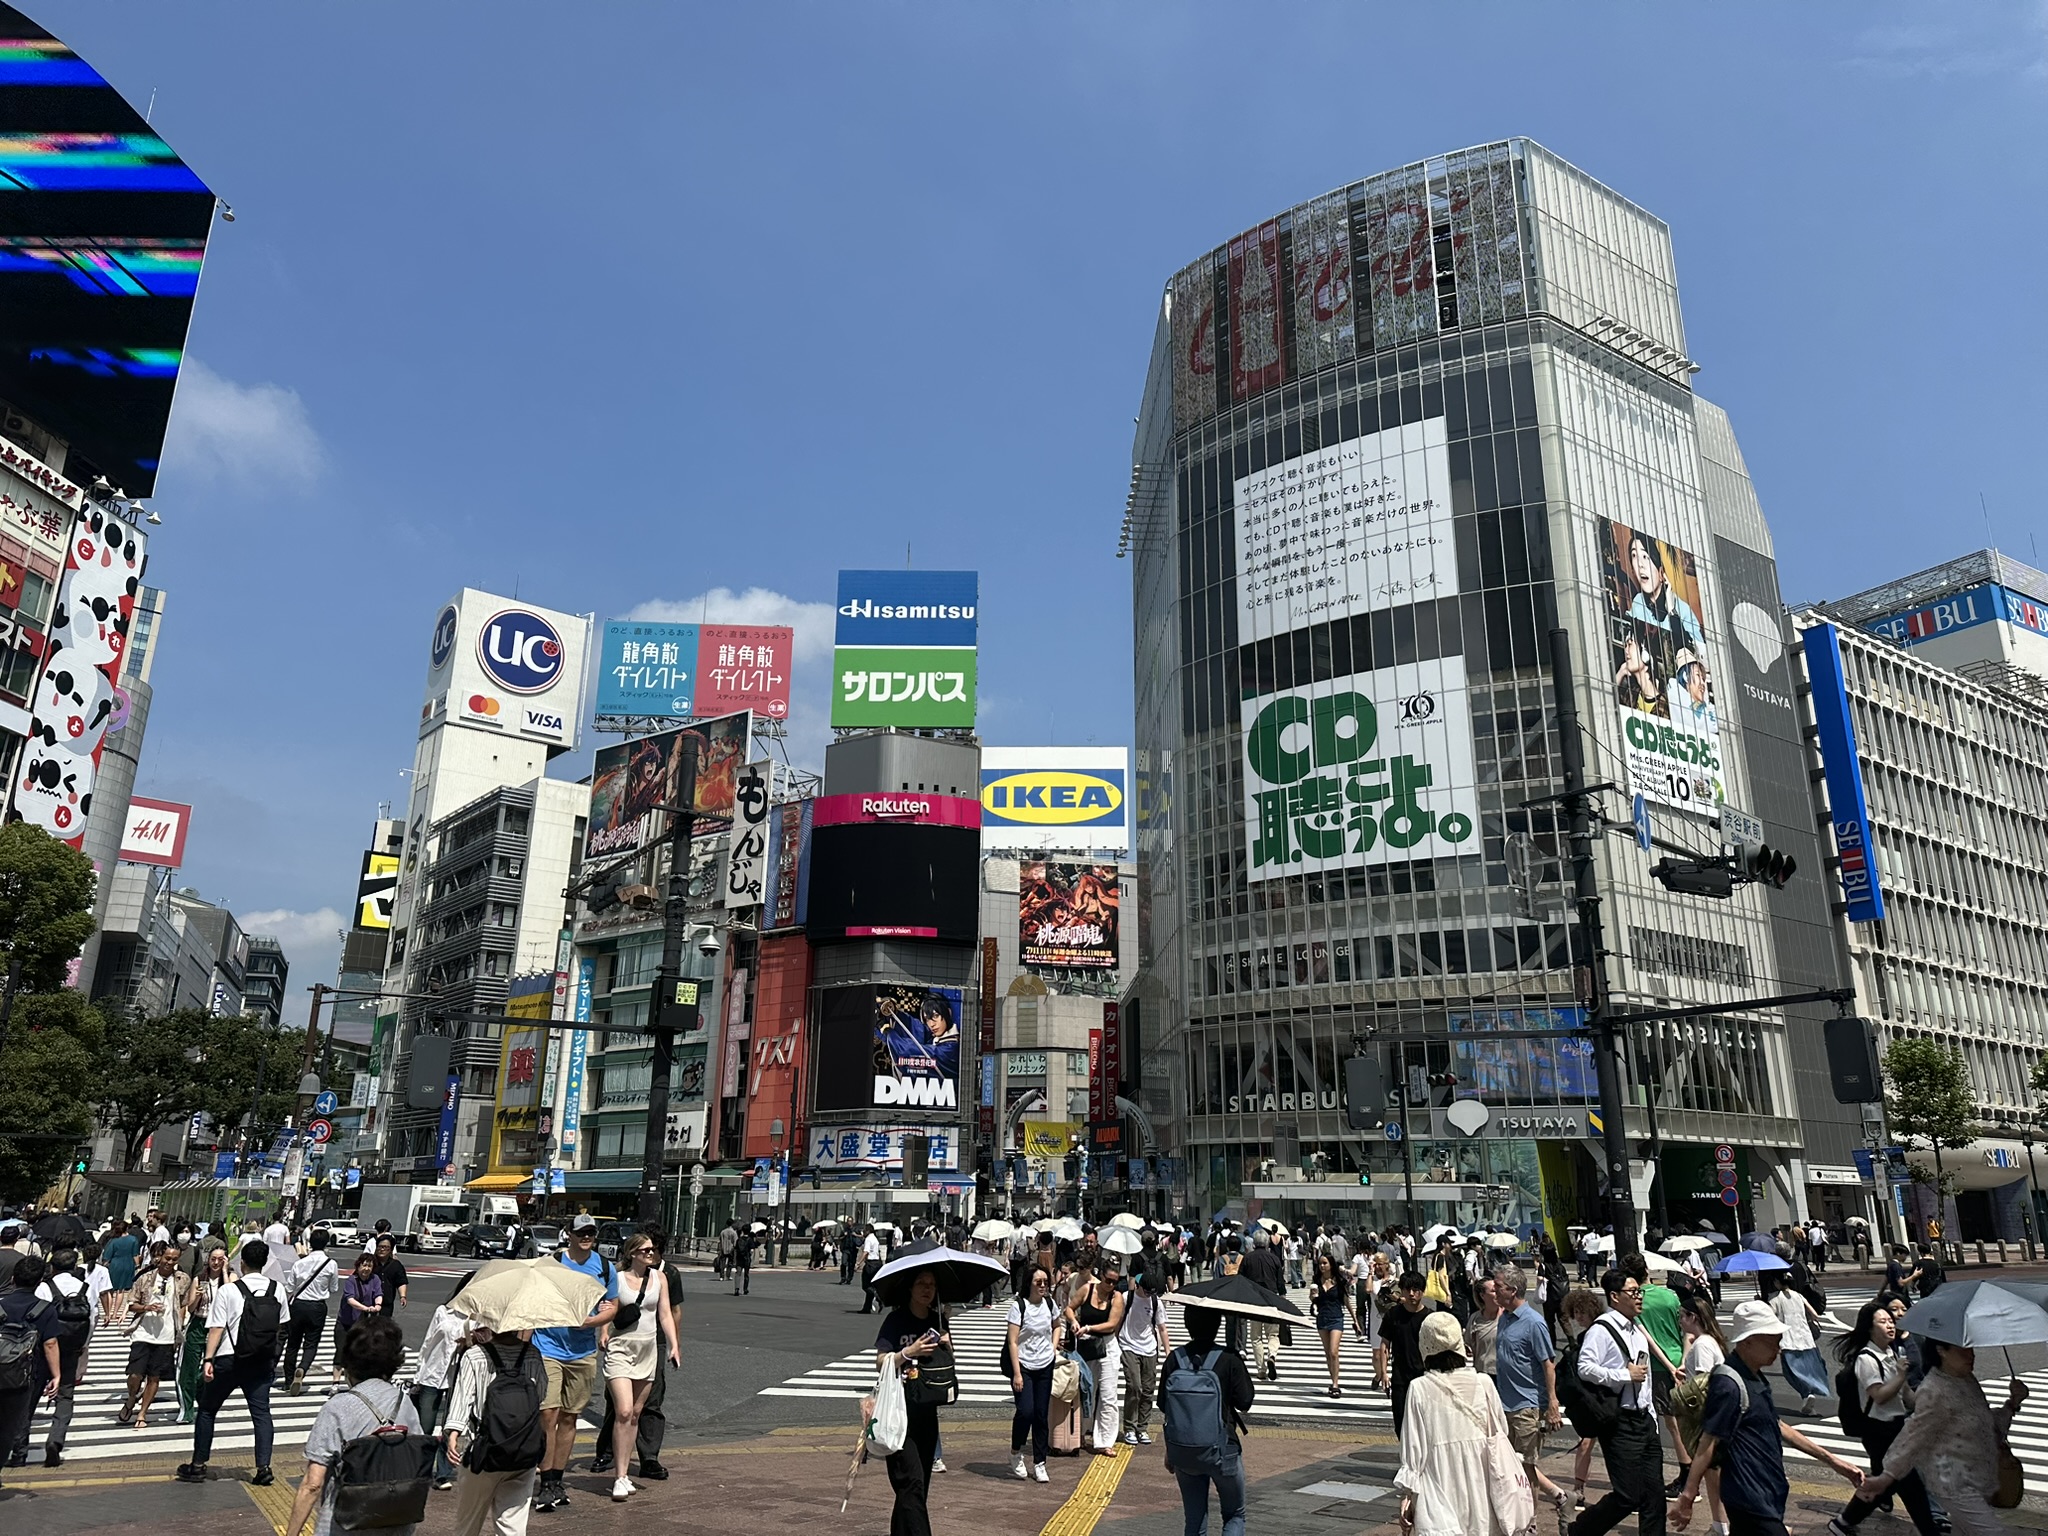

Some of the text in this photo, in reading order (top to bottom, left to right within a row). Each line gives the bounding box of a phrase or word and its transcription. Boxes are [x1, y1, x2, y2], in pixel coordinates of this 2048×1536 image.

[81, 543, 90, 555] こ
[839, 599, 975, 619] Hisamitsu
[112, 635, 121, 648] れ
[434, 618, 455, 655] UC
[610, 626, 694, 637] のど、直接、うるおう
[706, 629, 788, 641] のど、直接、うるおう
[488, 624, 556, 673] UC
[622, 641, 679, 665] 龍角散
[718, 644, 774, 668] 龍角散
[612, 666, 688, 689] ダイレクト
[709, 669, 783, 692] ダイレクト
[842, 671, 967, 703] サロンパス
[1744, 683, 1791, 710] TSUTAYA
[71, 720, 80, 732] よ
[526, 710, 562, 730] VISA
[992, 786, 1113, 808] IKEA
[1666, 774, 1690, 802] 10
[862, 797, 930, 814] Rakuten
[131, 819, 170, 843] H&M
[729, 766, 768, 901] もんじゃ
[1724, 810, 1761, 841] 渋谷駅前
[1836, 820, 1872, 905] SEIBU
[871, 927, 893, 935] Rakuten
[1105, 1011, 1117, 1070] カラオケ
[1009, 1065, 1046, 1073] クリニック
[1018, 1055, 1047, 1063] れいわ
[874, 1075, 956, 1106] DMM
[1229, 1089, 1400, 1113] STARBUS
[190, 1117, 201, 1139] LABI
[1500, 1116, 1577, 1129] TSUTAYA
[1984, 1148, 2020, 1169] SEIBU
